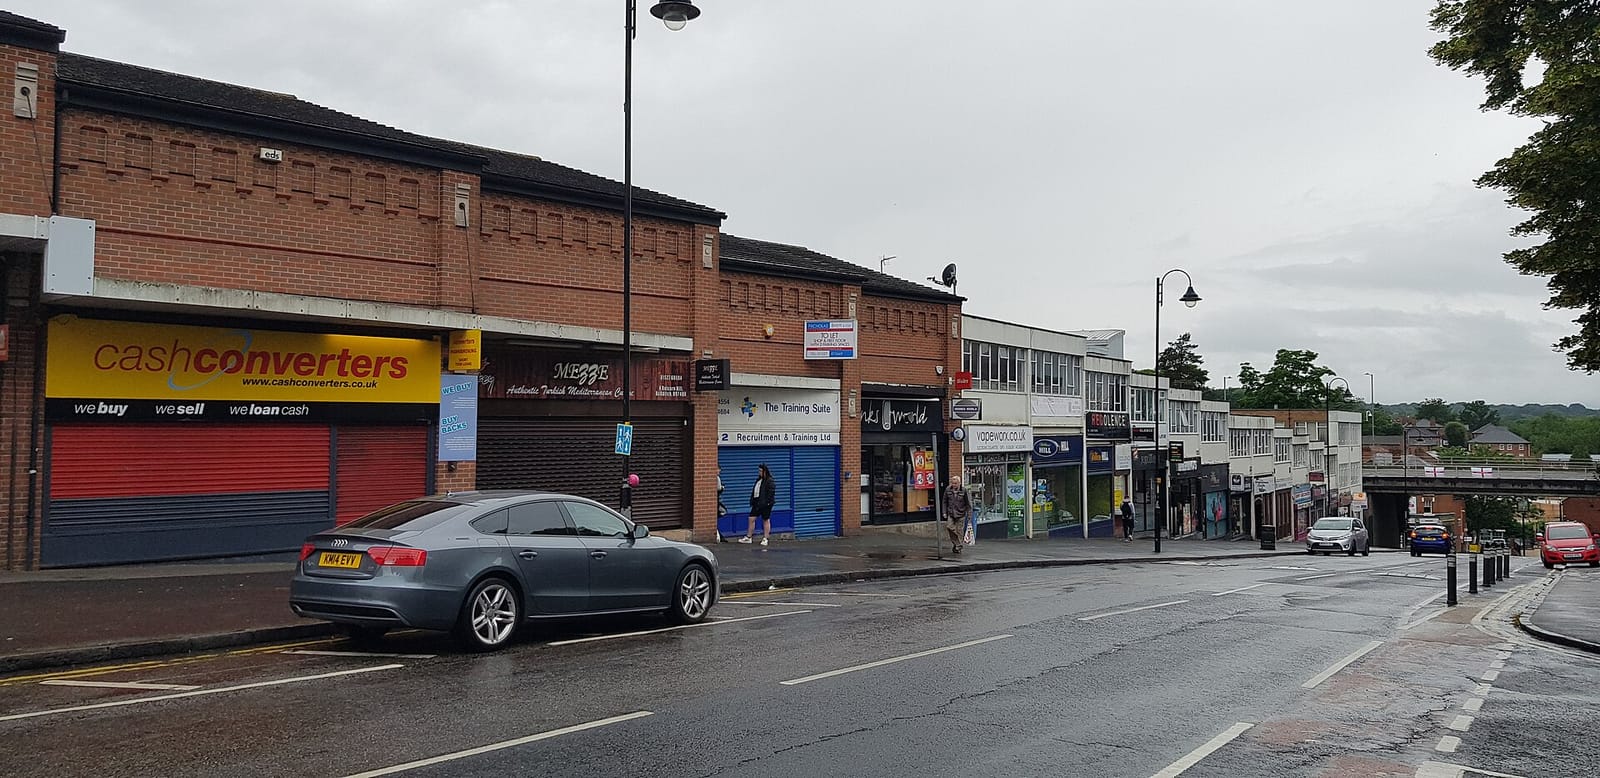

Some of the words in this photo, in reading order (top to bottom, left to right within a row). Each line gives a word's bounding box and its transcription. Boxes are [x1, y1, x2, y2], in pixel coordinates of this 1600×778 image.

[265, 150, 279, 159] eds
[554, 362, 609, 385] MEZZE
[242, 376, 378, 389] www.cashconverters.co.uk
[442, 386, 455, 394] WE
[456, 382, 472, 392] BUY
[506, 384, 539, 395] Authentic
[541, 384, 566, 395] Turkish
[567, 385, 613, 397] Mediterranean
[764, 402, 779, 412] The
[782, 402, 809, 415] Training
[812, 403, 831, 413] Suite
[442, 415, 458, 425] BUY
[1091, 413, 1126, 427] REDOLENCE
[441, 422, 467, 433] BACKS
[721, 433, 729, 441] 2
[736, 433, 781, 441] Recruitment
[783, 433, 789, 441] &
[792, 433, 818, 442] Training
[820, 433, 831, 441] Ltd
